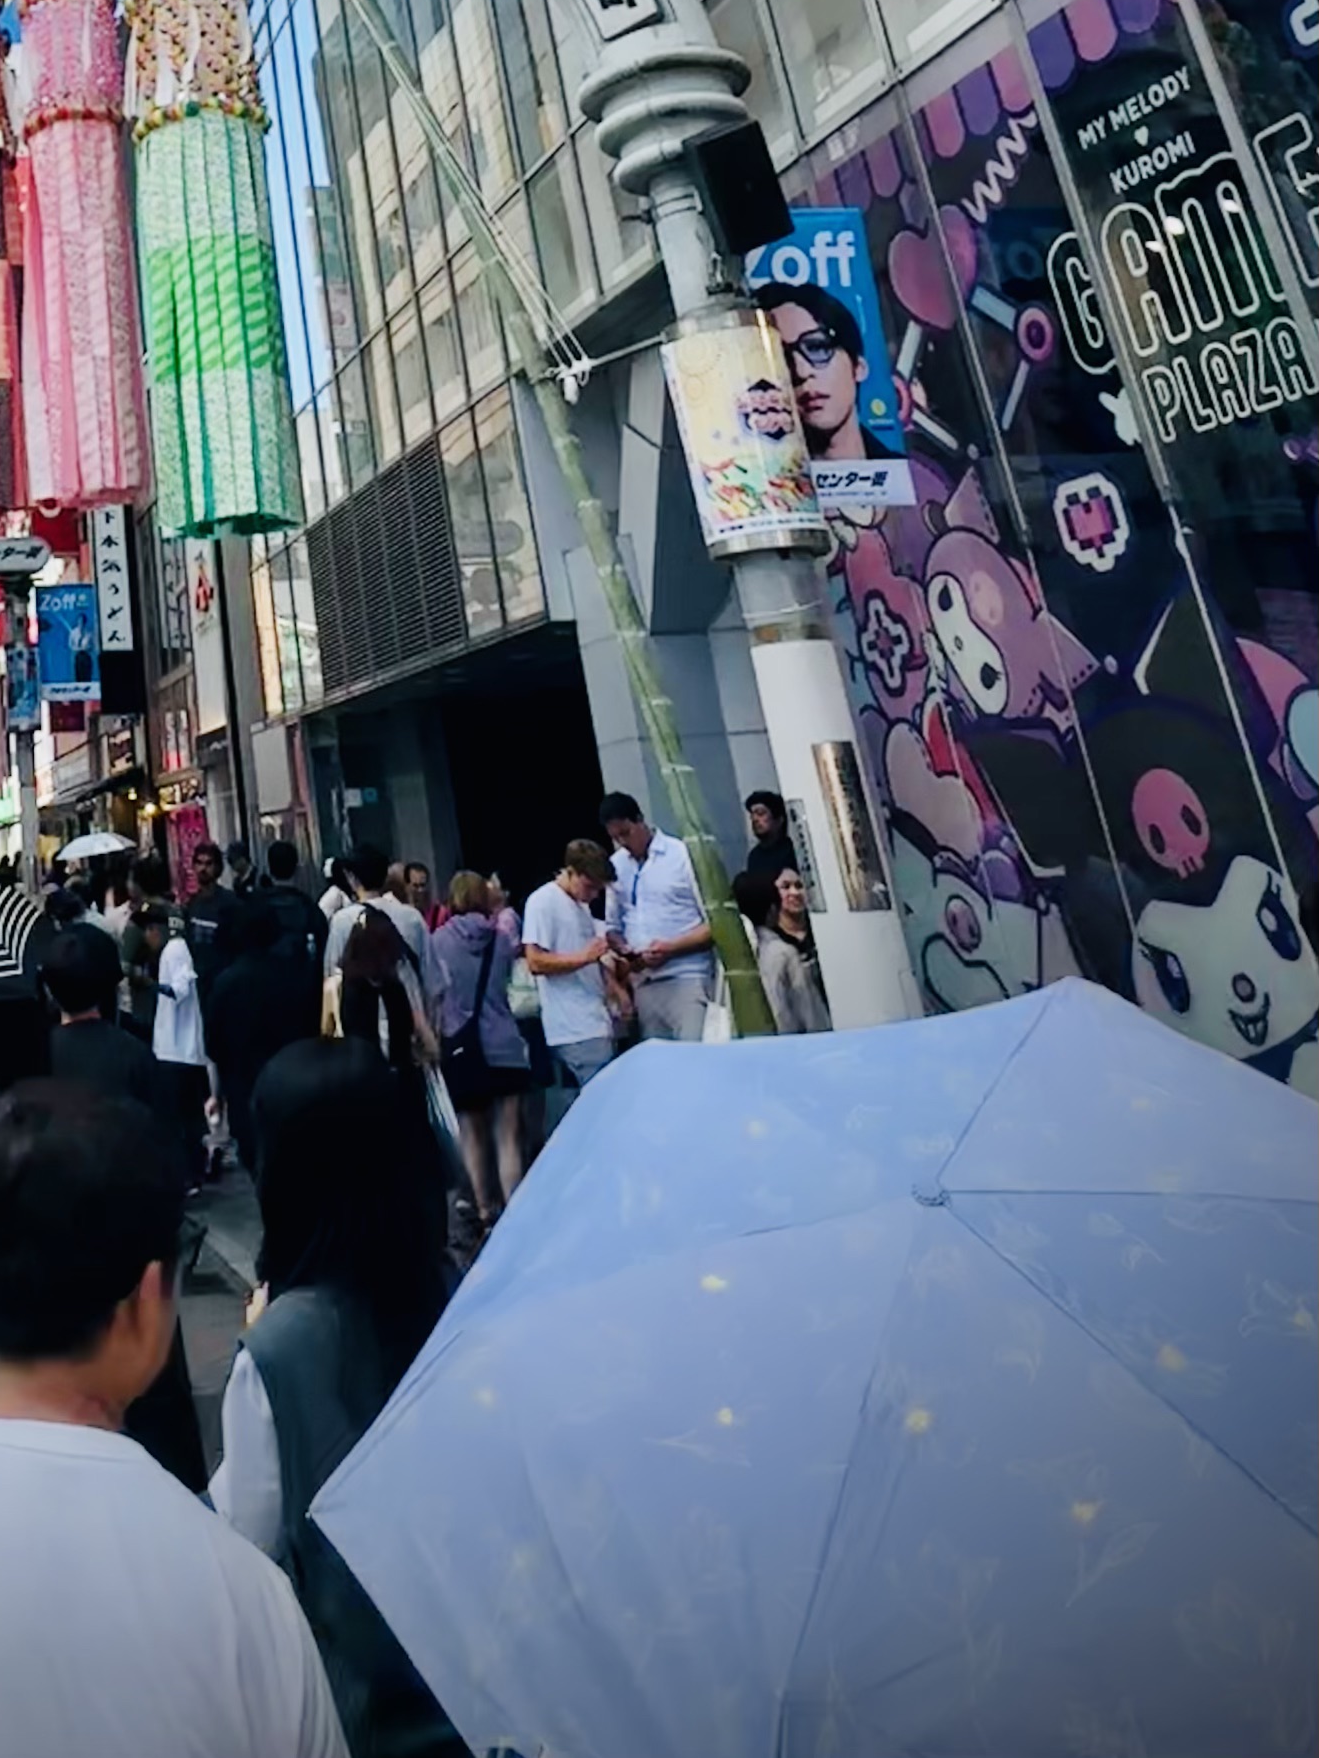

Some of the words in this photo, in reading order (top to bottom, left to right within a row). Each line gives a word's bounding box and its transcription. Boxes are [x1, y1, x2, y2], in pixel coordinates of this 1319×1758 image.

[1077, 115, 1109, 151] MY
[1109, 66, 1193, 130] MELODY
[1108, 130, 1196, 194] KUROMI
[745, 230, 856, 288] Zoff
[1047, 111, 1319, 375] GAME
[1141, 316, 1319, 444] PLAZA
[39, 593, 76, 612] Zoff
